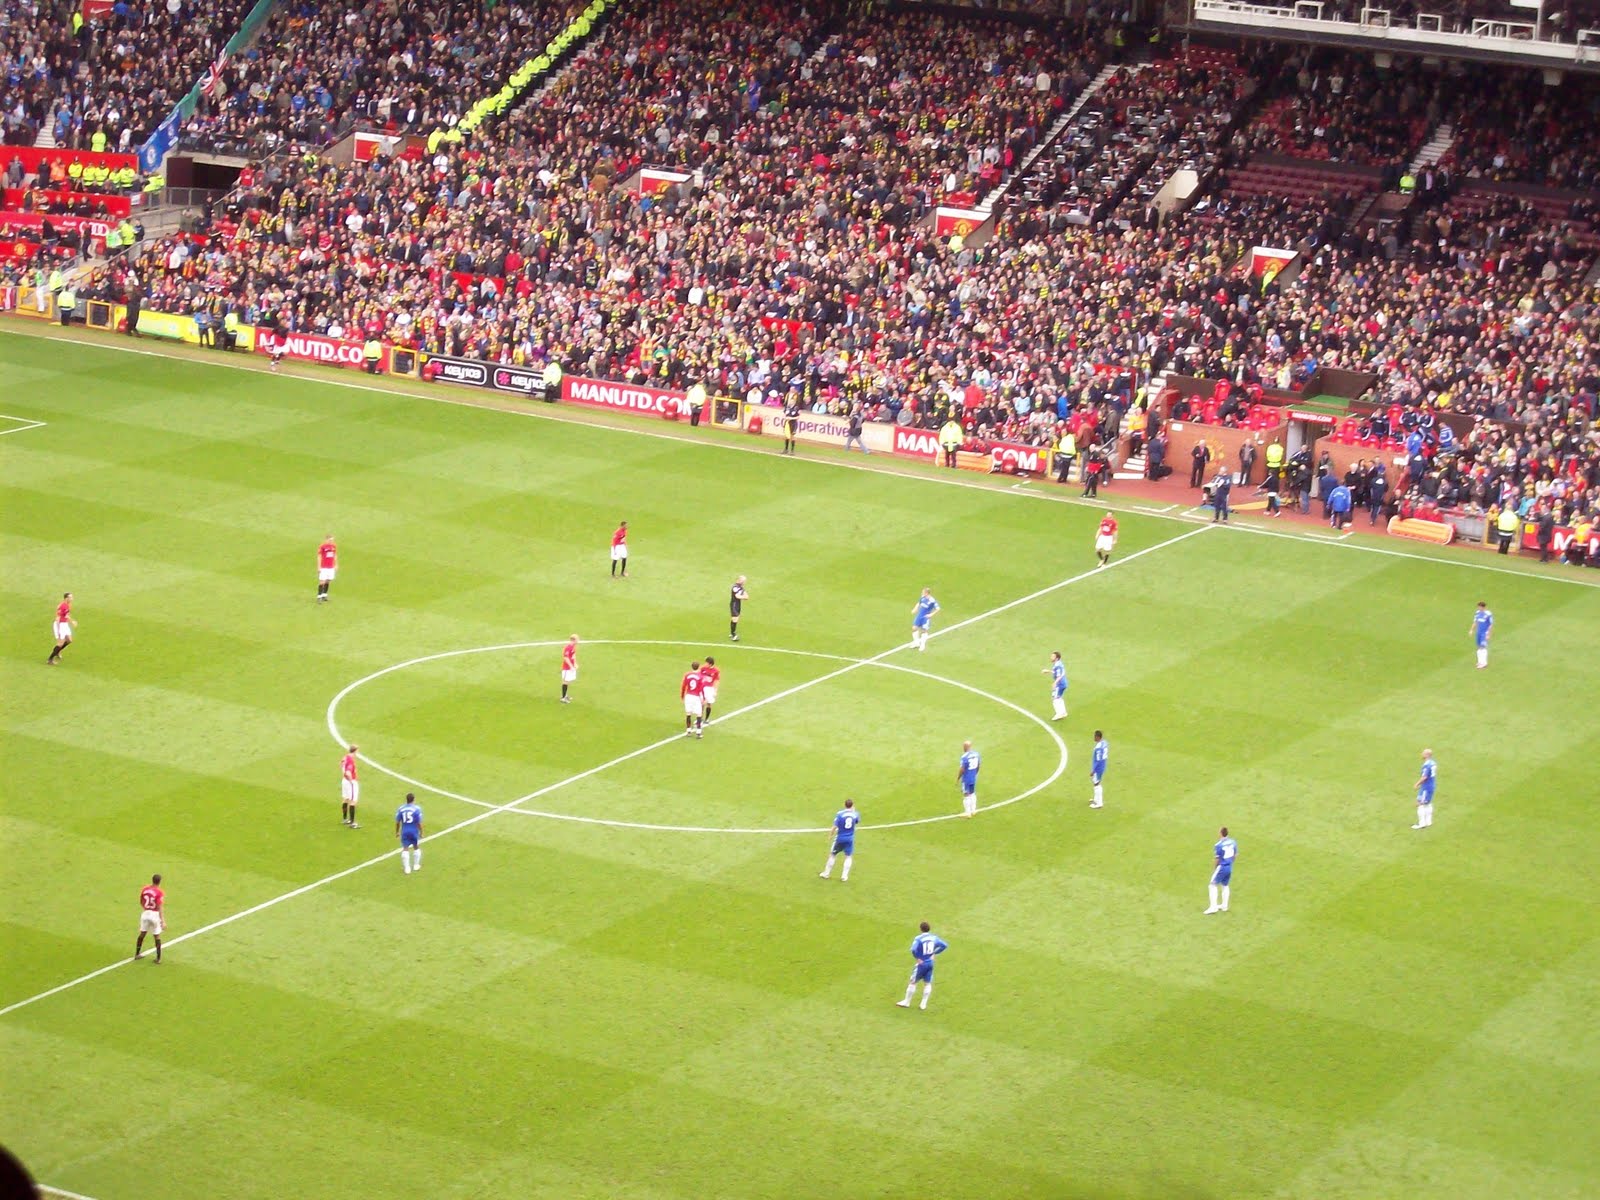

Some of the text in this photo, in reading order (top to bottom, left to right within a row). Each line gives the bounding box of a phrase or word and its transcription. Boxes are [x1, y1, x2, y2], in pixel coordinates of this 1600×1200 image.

[260, 333, 363, 363] MNUTD.CO
[690, 679, 697, 690] 9
[402, 811, 414, 823] 15
[845, 817, 852, 829] 8
[143, 895, 156, 909] 25
